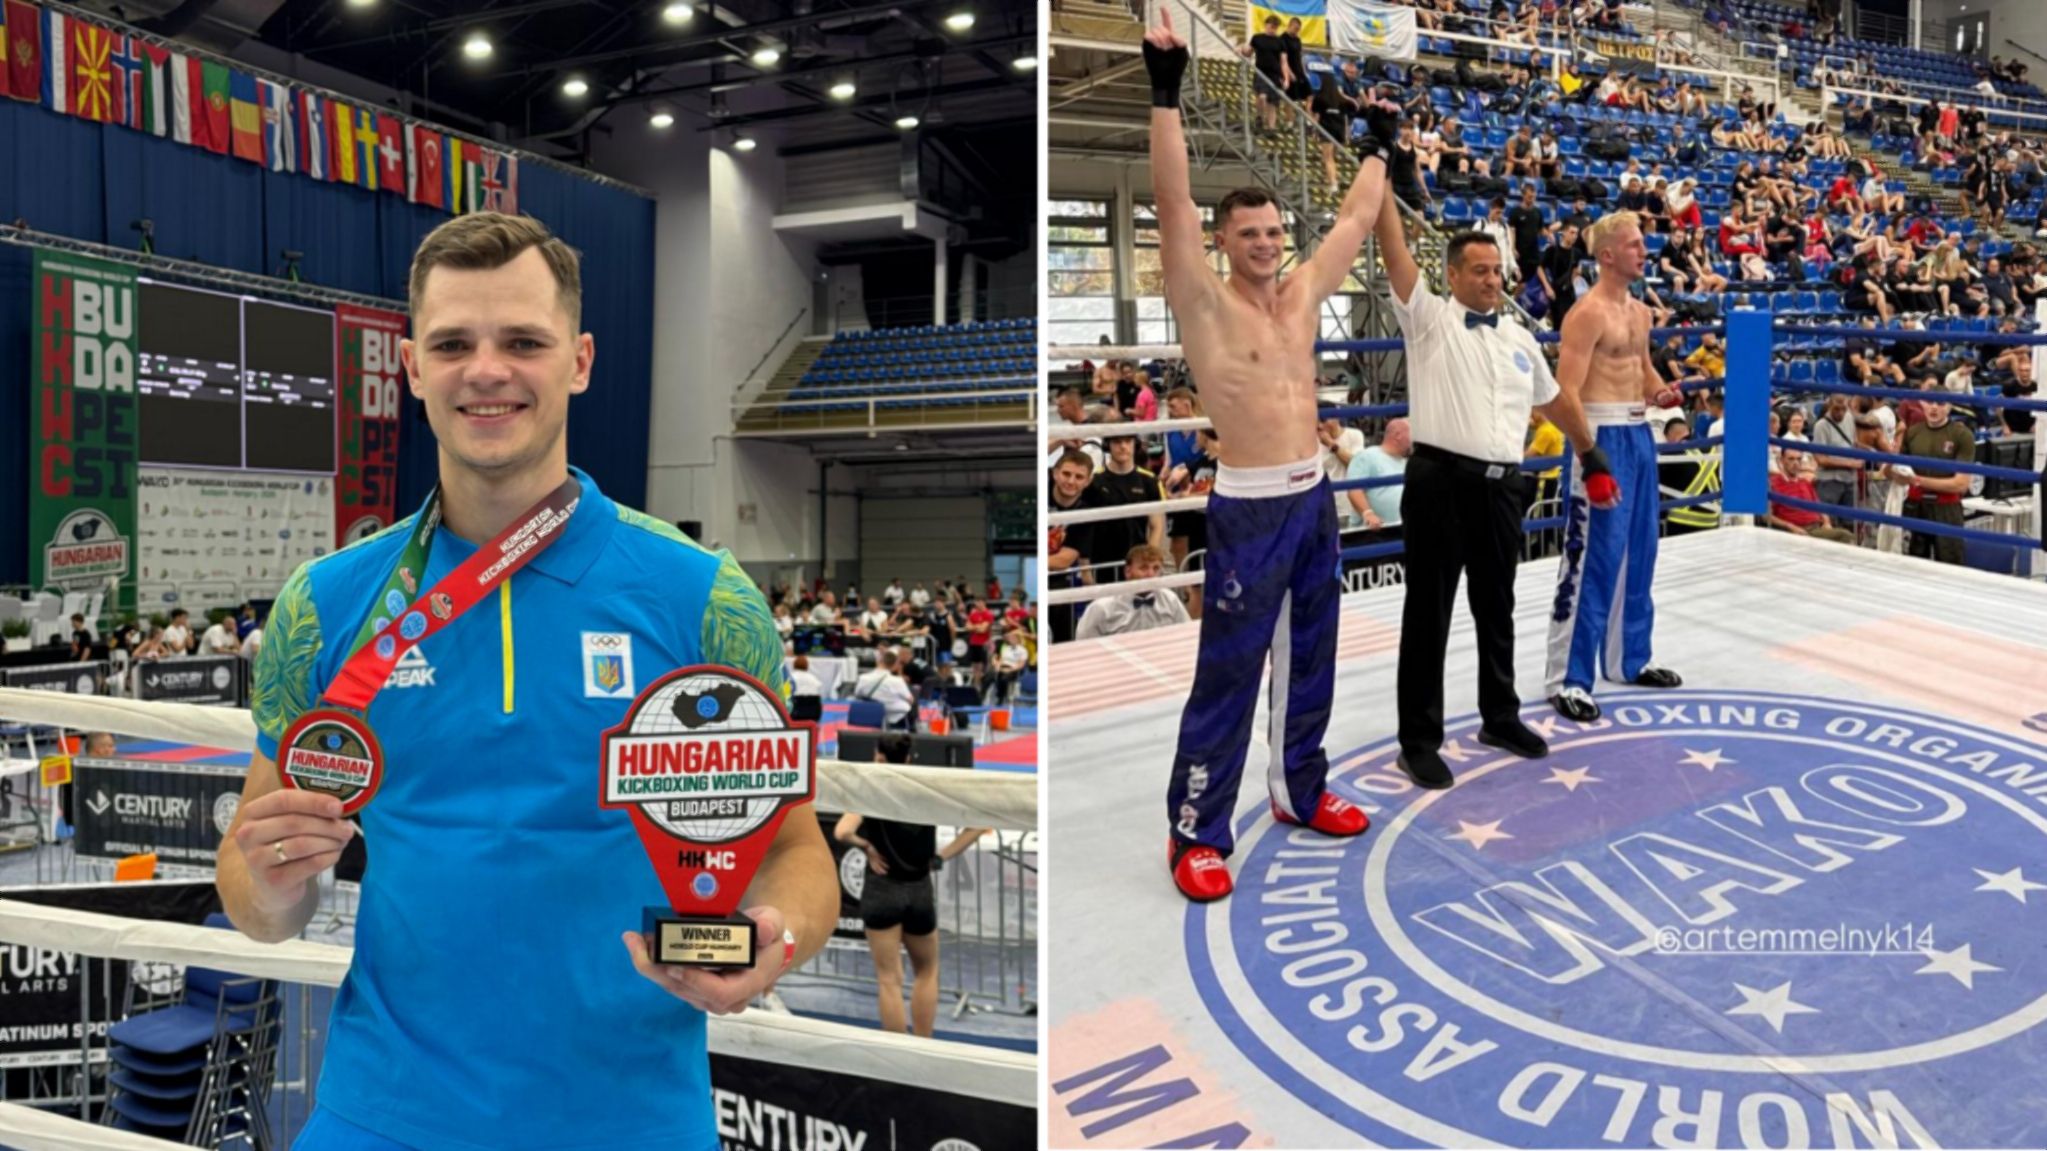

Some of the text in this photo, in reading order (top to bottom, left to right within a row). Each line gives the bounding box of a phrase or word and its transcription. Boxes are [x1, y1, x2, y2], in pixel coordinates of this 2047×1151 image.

[1340, 562, 1406, 595] NTURY
[293, 749, 370, 777] HUNGARIAN
[618, 737, 800, 777] HUNGARIAN
[617, 771, 800, 795] KICKBOXING WORLD CUP
[114, 793, 192, 819] CENTURY
[670, 800, 744, 817] BUDAPEST
[1410, 763, 1968, 985] WAKO
[681, 927, 732, 941] WINNER
[1261, 803, 1500, 1083] ASSOCIATIO
[19, 977, 68, 994] ARTS
[710, 1086, 868, 1149] ENTURY
